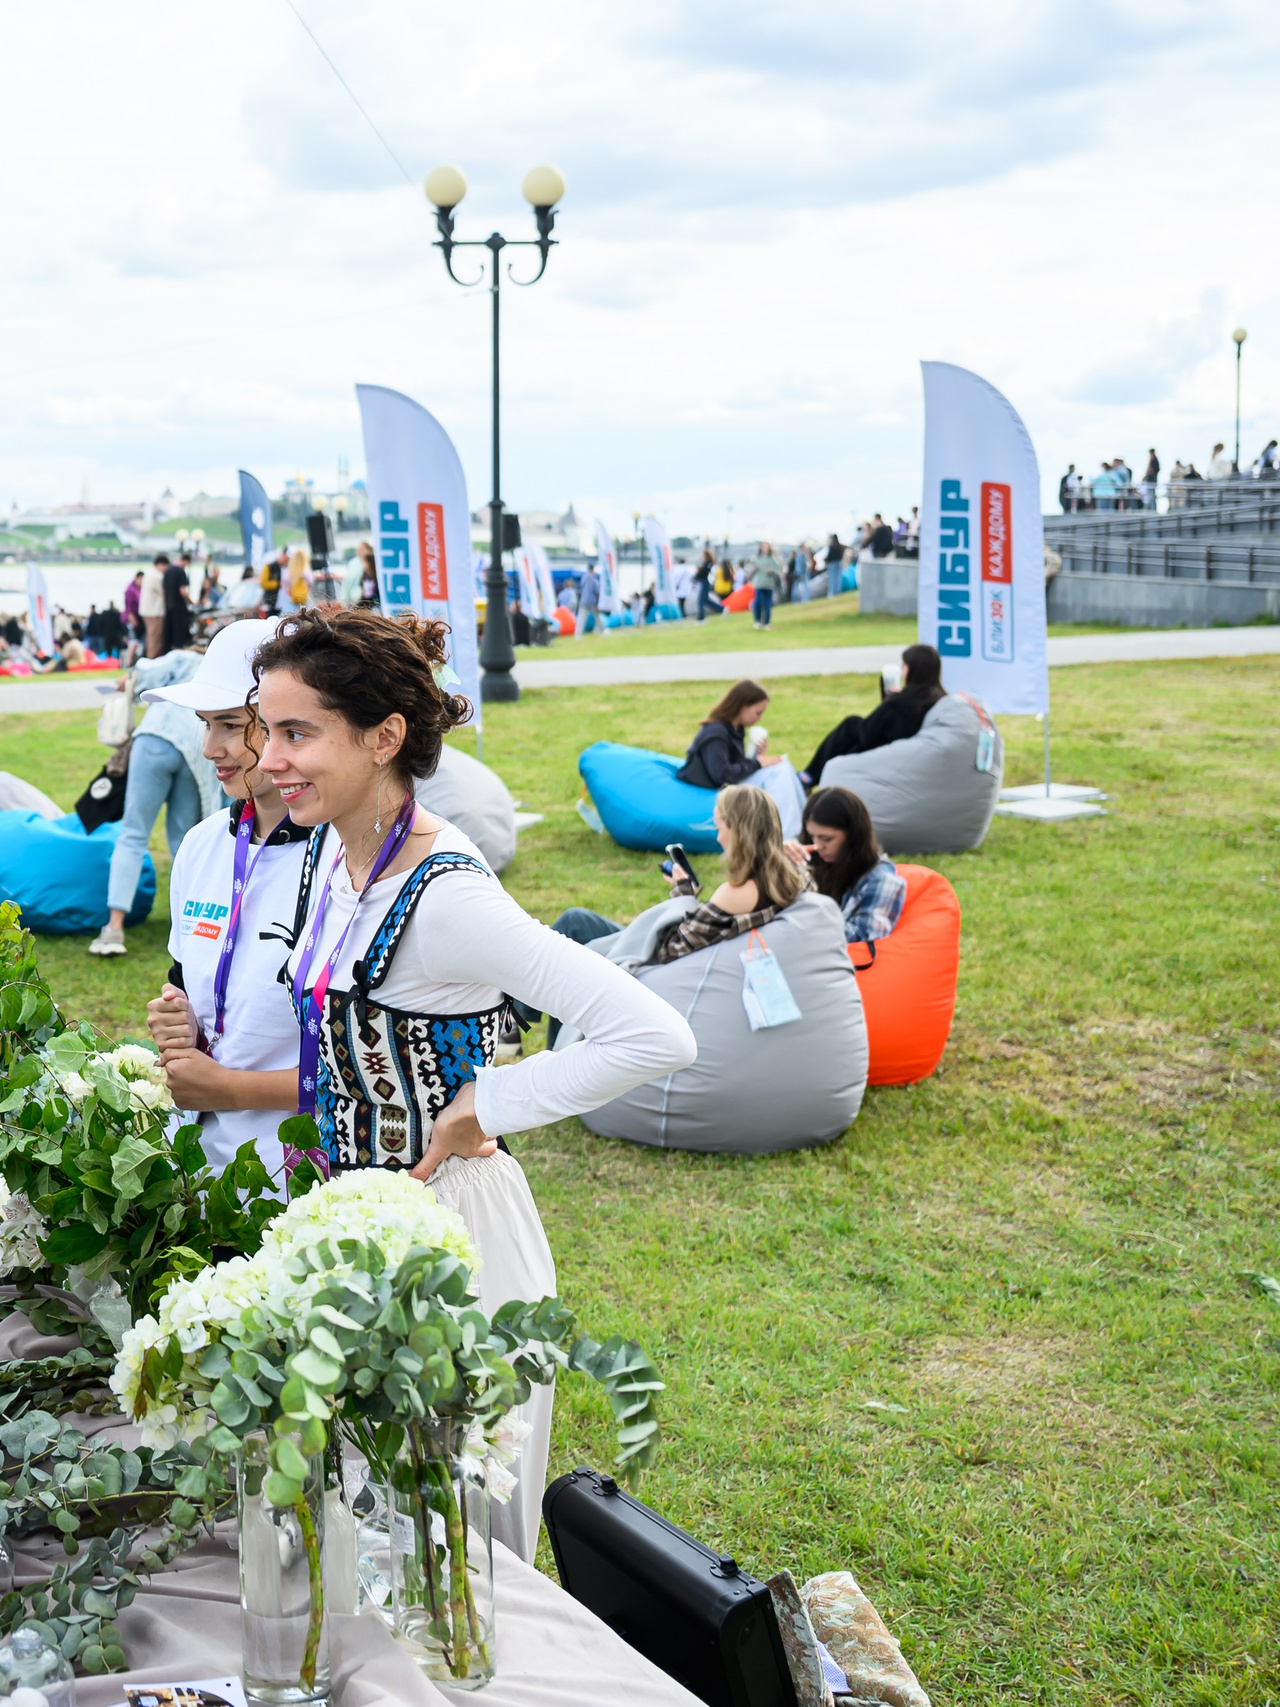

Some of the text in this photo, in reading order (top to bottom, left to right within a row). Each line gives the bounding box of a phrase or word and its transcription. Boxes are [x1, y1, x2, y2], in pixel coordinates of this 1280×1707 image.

[423, 508, 442, 596] КАЖДОМУ
[937, 479, 971, 657] СИБУР
[988, 488, 1004, 578] КАЖДОМУ
